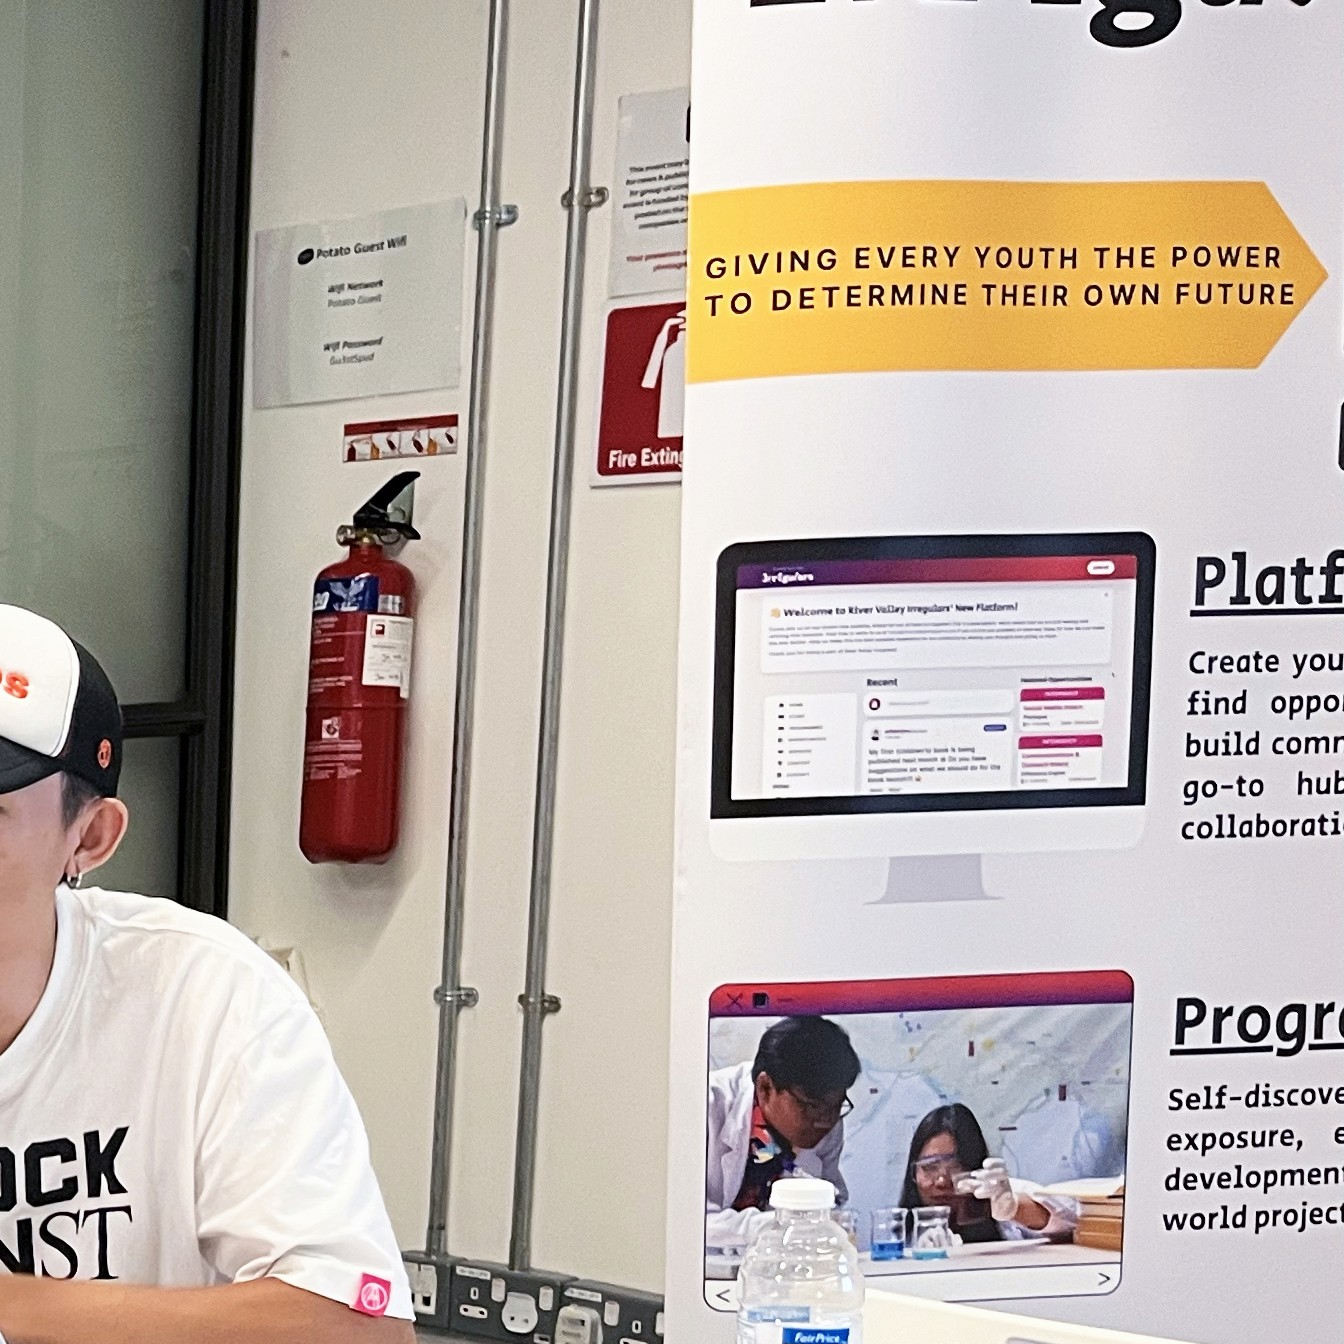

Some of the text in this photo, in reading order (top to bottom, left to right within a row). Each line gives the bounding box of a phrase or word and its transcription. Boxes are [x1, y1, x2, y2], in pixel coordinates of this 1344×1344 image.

[316, 246, 351, 259] Potato
[353, 242, 385, 254] Guest
[705, 248, 837, 279] GIVING
[854, 246, 961, 270] EVERY
[975, 246, 1078, 270] YOUTH
[1093, 246, 1156, 270] THE
[1171, 245, 1282, 270] POWER
[705, 283, 1296, 317] TO DETERMINE THEIR OWN FUTURE
[608, 449, 637, 468] Fire
[783, 606, 833, 617] Welcome
[835, 606, 846, 615] to
[848, 606, 873, 615] River
[875, 605, 905, 616] Valley
[1189, 651, 1279, 674] Create
[1186, 690, 1344, 720] find oppo
[1186, 731, 1260, 757] build
[1183, 775, 1264, 805] go-to
[1181, 811, 1344, 840] collaborati
[1166, 1128, 1303, 1157] exposure,
[1162, 1204, 1247, 1231] world
